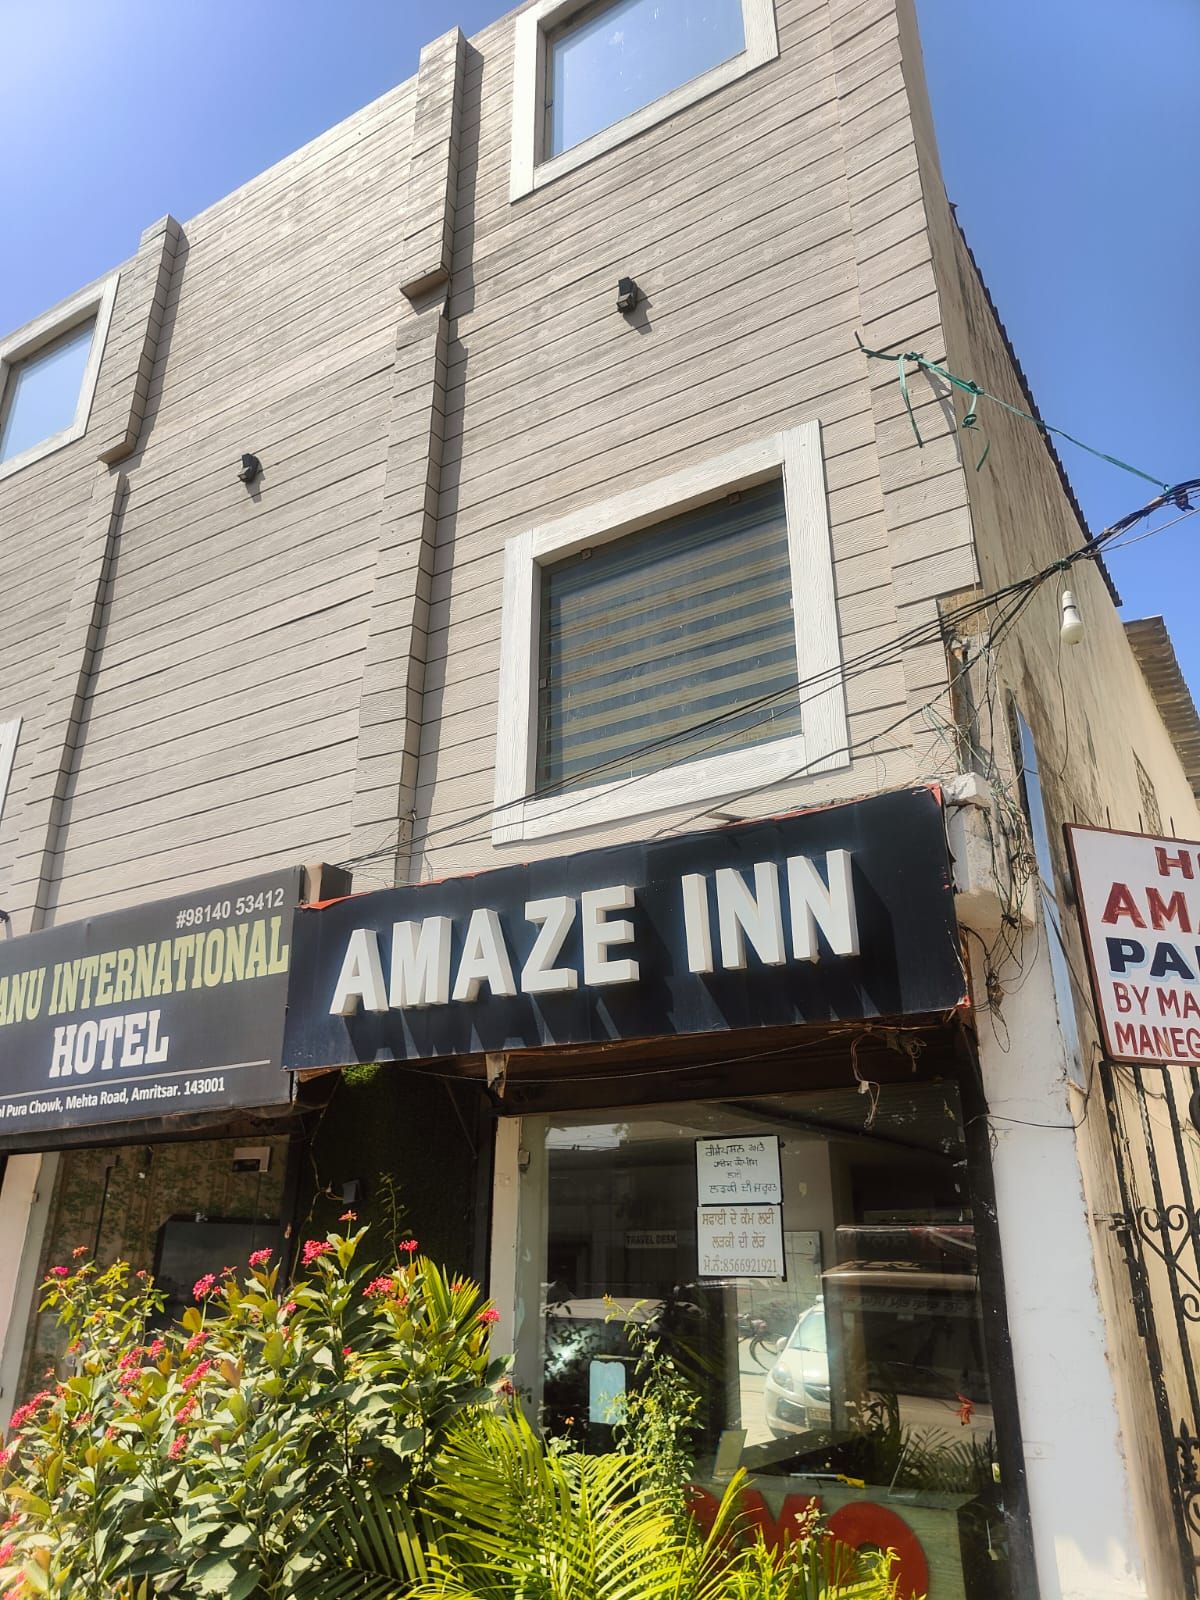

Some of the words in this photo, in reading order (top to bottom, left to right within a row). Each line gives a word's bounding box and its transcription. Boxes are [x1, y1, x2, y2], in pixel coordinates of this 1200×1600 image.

[1154, 846, 1200, 880] H
[176, 901, 231, 928] #98140
[235, 888, 284, 916] 53412
[1101, 882, 1200, 935] AM
[329, 885, 640, 1017] AMAZE
[682, 849, 860, 974] INN
[48, 915, 289, 1016] INTERNATIONAL
[1106, 937, 1200, 980] PA
[1113, 981, 1149, 1015] BY
[49, 1009, 169, 1078] HOTEL
[1114, 1021, 1200, 1059] MANEG
[6, 1104, 27, 1117] Pura
[29, 1097, 63, 1112] Chowk,
[66, 1094, 98, 1109] Mehta
[100, 1088, 129, 1105] Road,
[131, 1084, 181, 1102] Amritsar.
[184, 1077, 225, 1096] 143001
